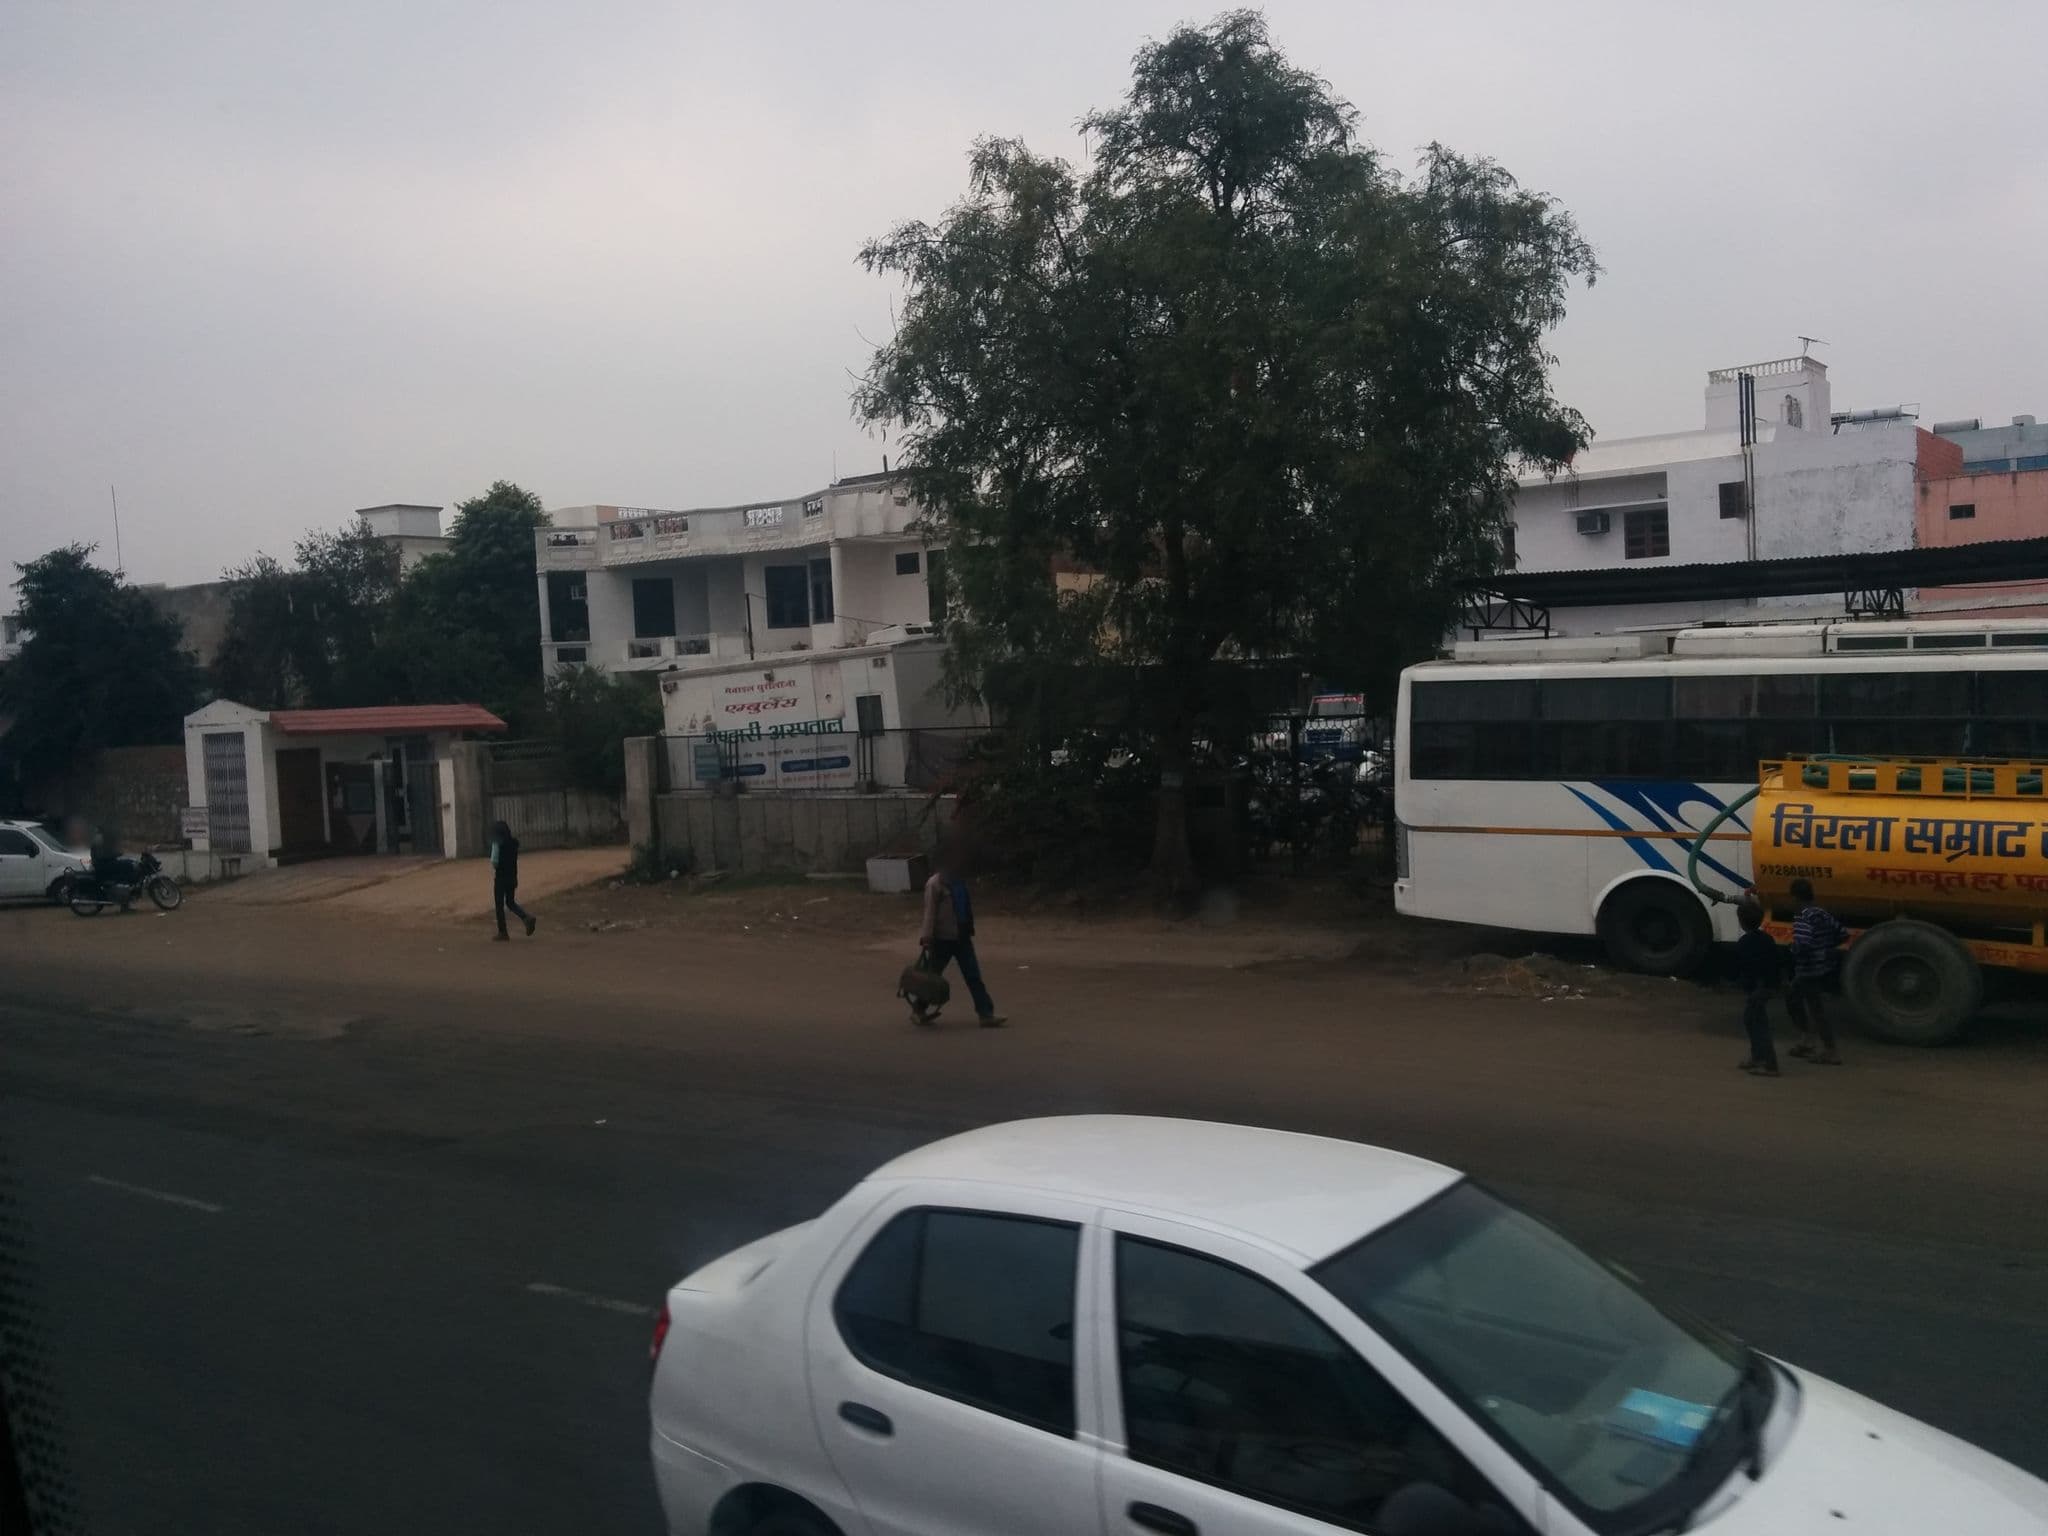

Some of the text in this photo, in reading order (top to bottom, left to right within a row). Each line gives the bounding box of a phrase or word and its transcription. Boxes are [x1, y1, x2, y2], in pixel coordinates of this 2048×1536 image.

[768, 718, 843, 740] अस्पताल
[1770, 803, 1899, 852] बिरला
[1905, 818, 2034, 863] सम्राट
[1970, 872, 2009, 892] हर
